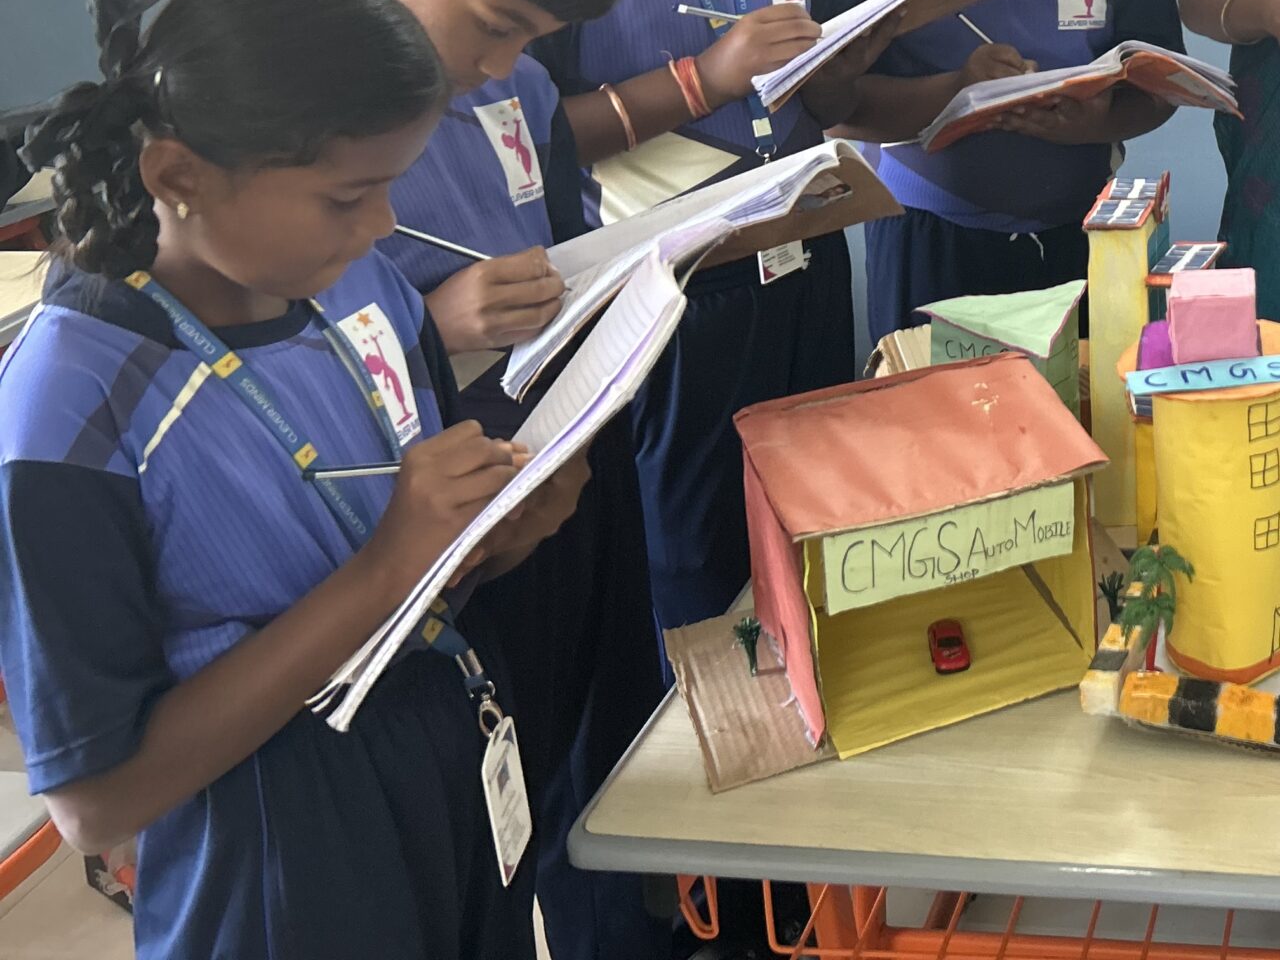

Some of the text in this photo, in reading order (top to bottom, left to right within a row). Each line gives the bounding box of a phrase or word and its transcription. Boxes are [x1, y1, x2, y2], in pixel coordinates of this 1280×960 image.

[178, 321, 217, 355] CLEVER
[945, 340, 1010, 359] CMG
[240, 378, 298, 444] CLEVER MINDS
[841, 521, 960, 593] CMGS
